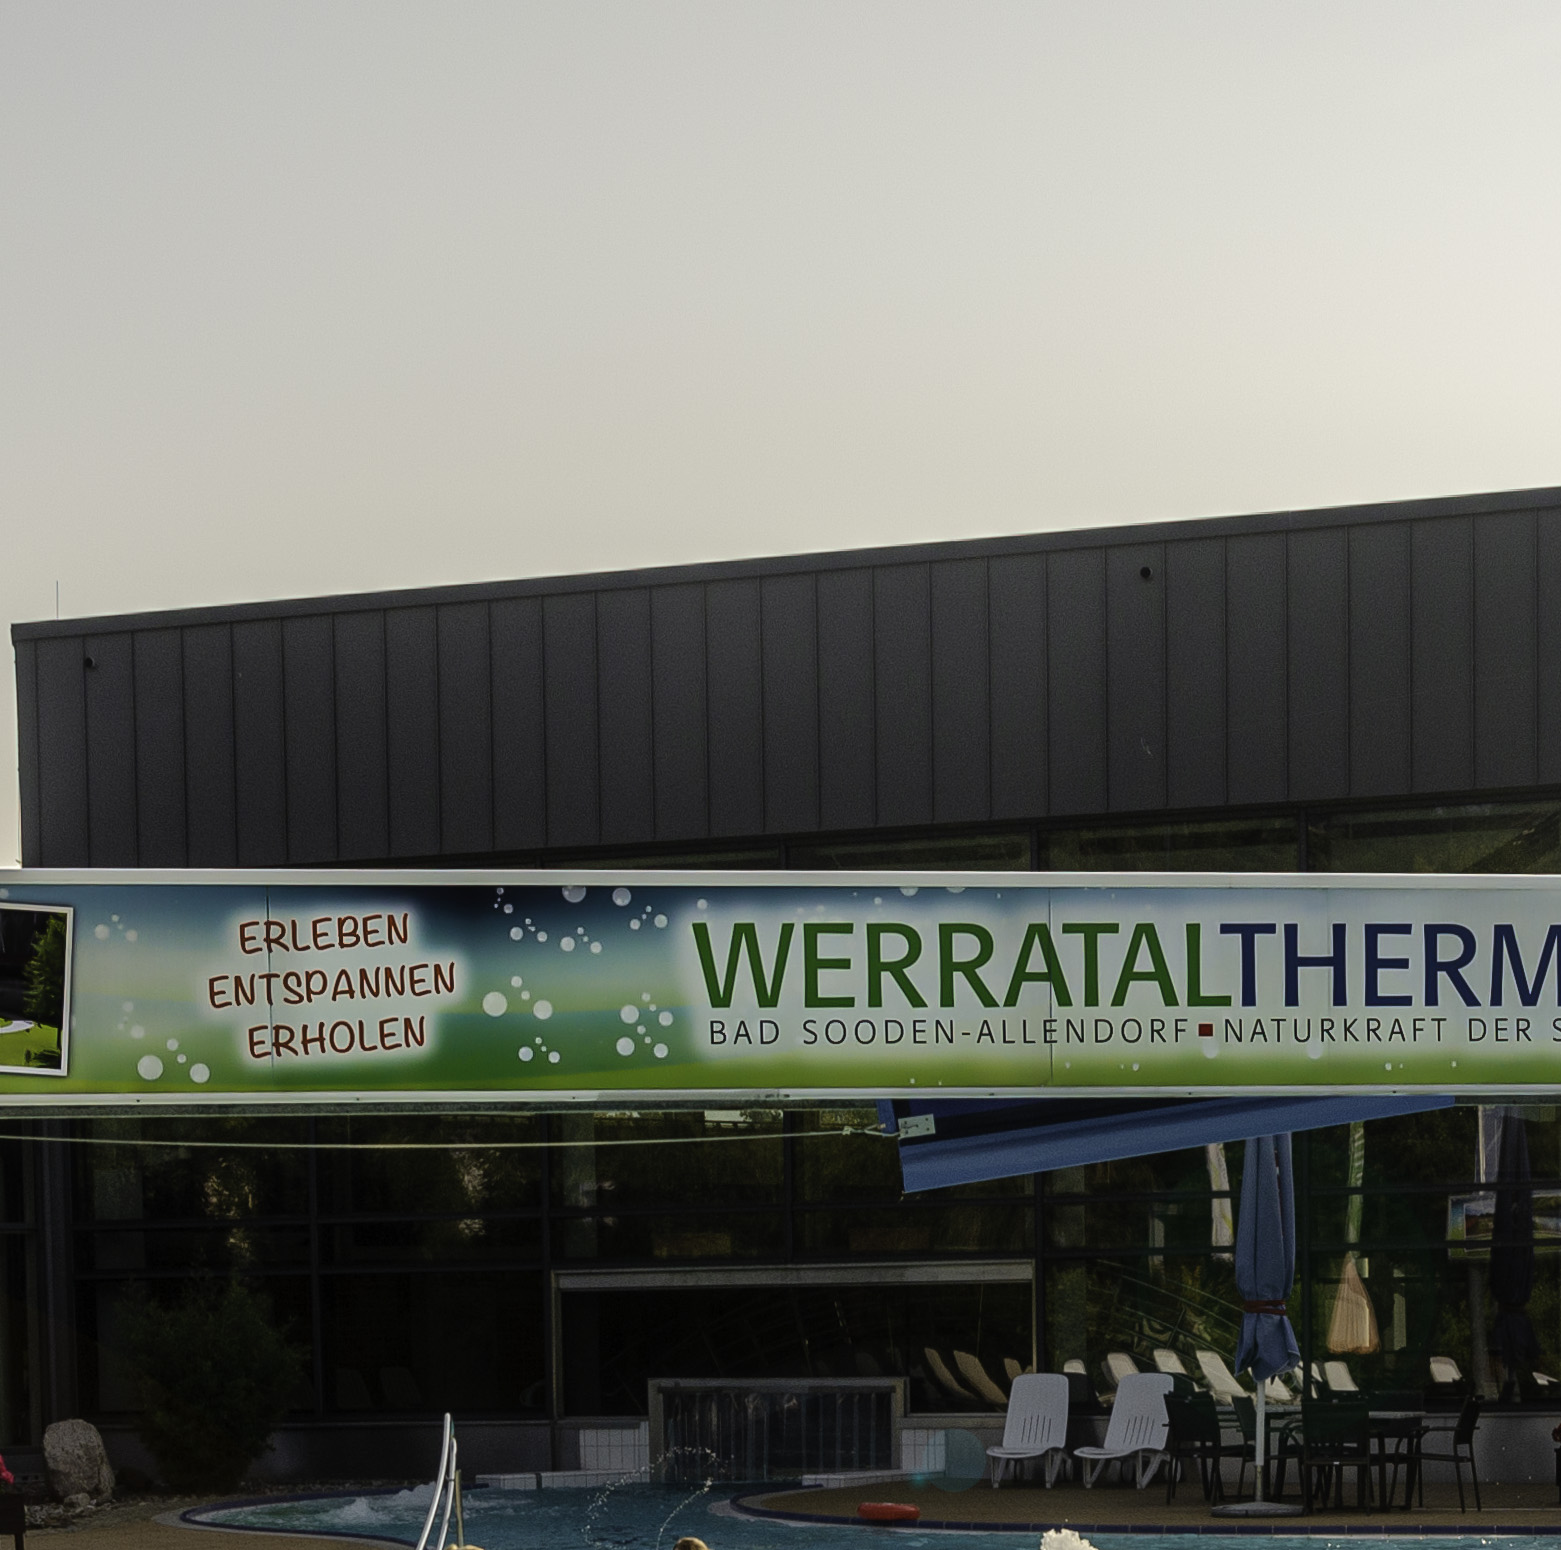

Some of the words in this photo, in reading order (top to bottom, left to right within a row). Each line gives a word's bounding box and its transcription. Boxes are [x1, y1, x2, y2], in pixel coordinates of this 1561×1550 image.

[239, 912, 410, 955] ERLEBEN
[208, 961, 456, 1009] ENTSPANNEN
[247, 1016, 427, 1060] ERHOLEN
[709, 1019, 780, 1045] BAD
[802, 1018, 1188, 1045] SOODEN-ALLENDORF
[1224, 1017, 1447, 1043] NATURKRAFT
[1468, 1017, 1532, 1042] DER
